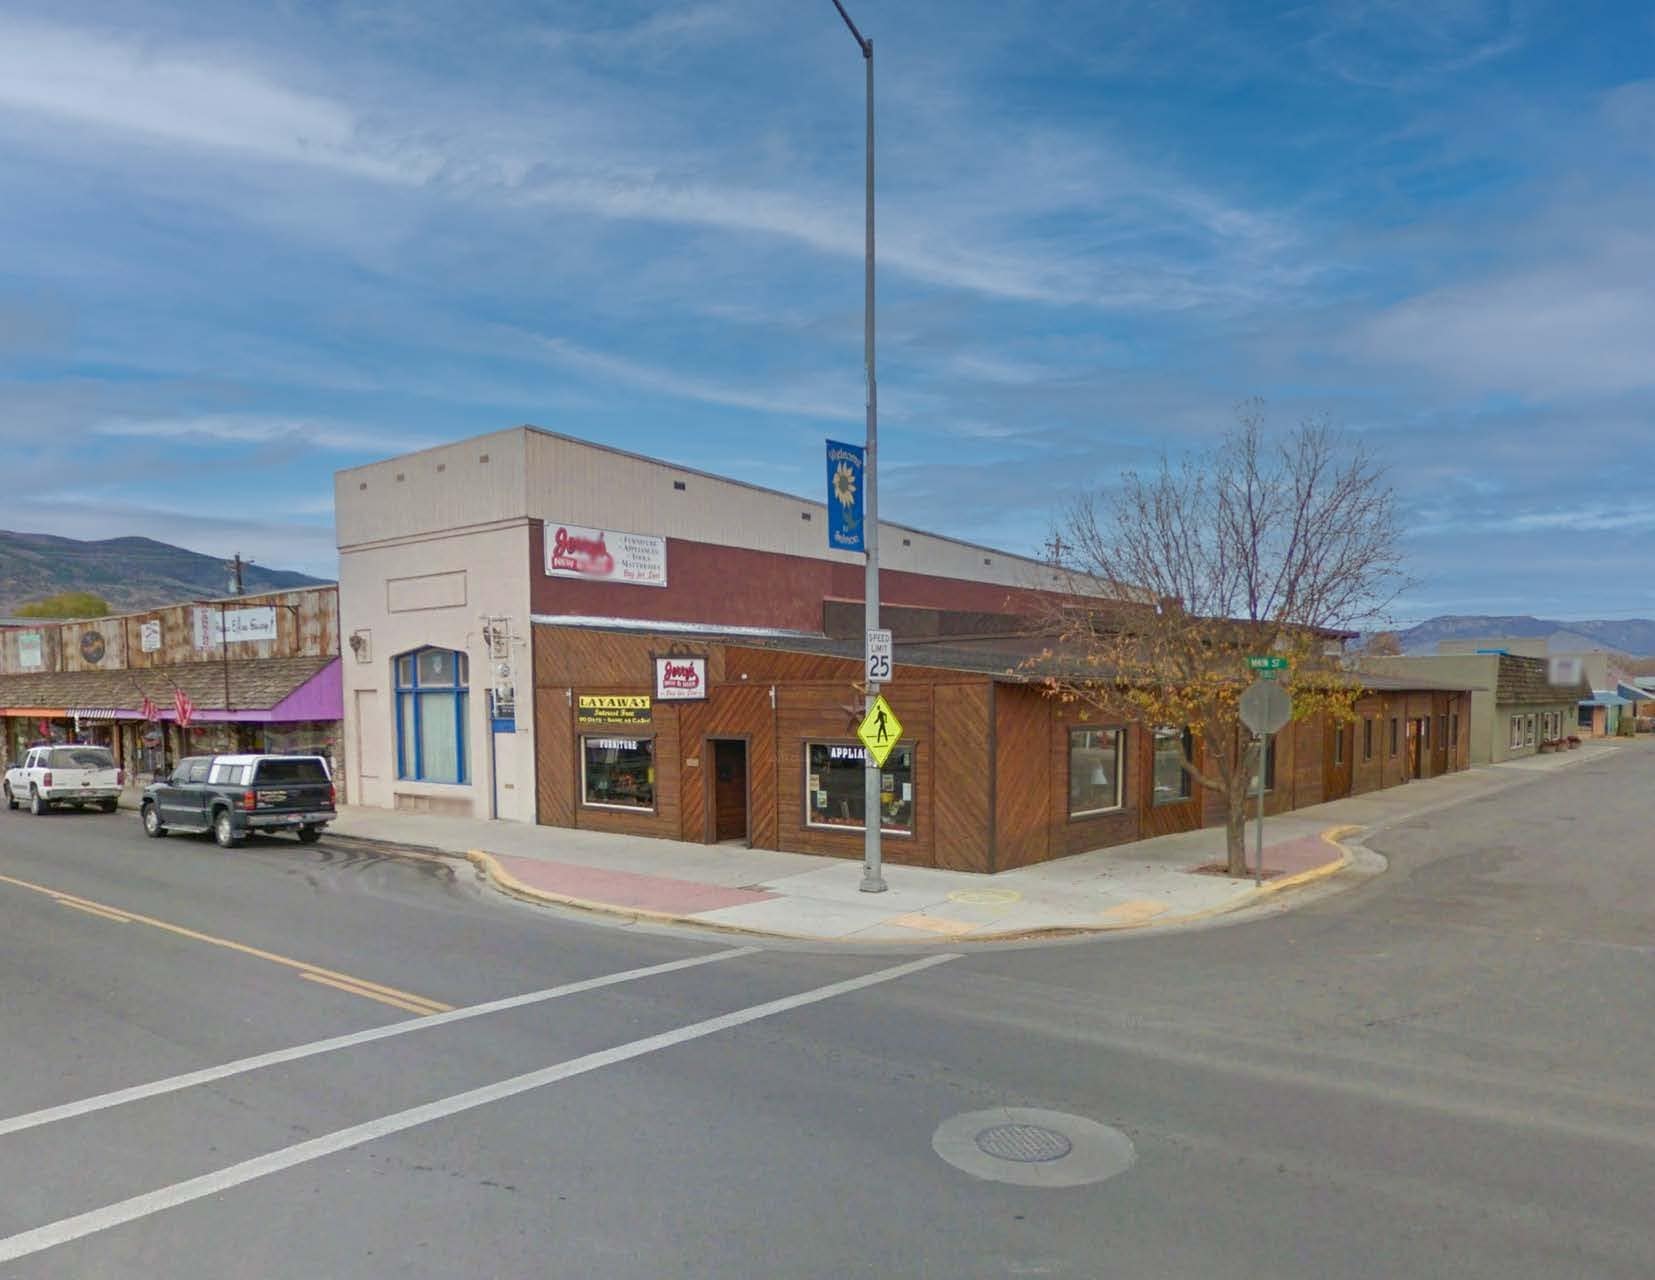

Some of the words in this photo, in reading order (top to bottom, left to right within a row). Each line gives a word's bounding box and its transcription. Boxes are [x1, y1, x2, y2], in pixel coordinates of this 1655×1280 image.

[868, 633, 889, 643] SPEED
[871, 644, 888, 653] LIMIT
[664, 661, 698, 681] Jerry's
[869, 655, 889, 677] 25
[580, 698, 649, 707] LAYAWAY
[600, 739, 637, 750] FURNITURE
